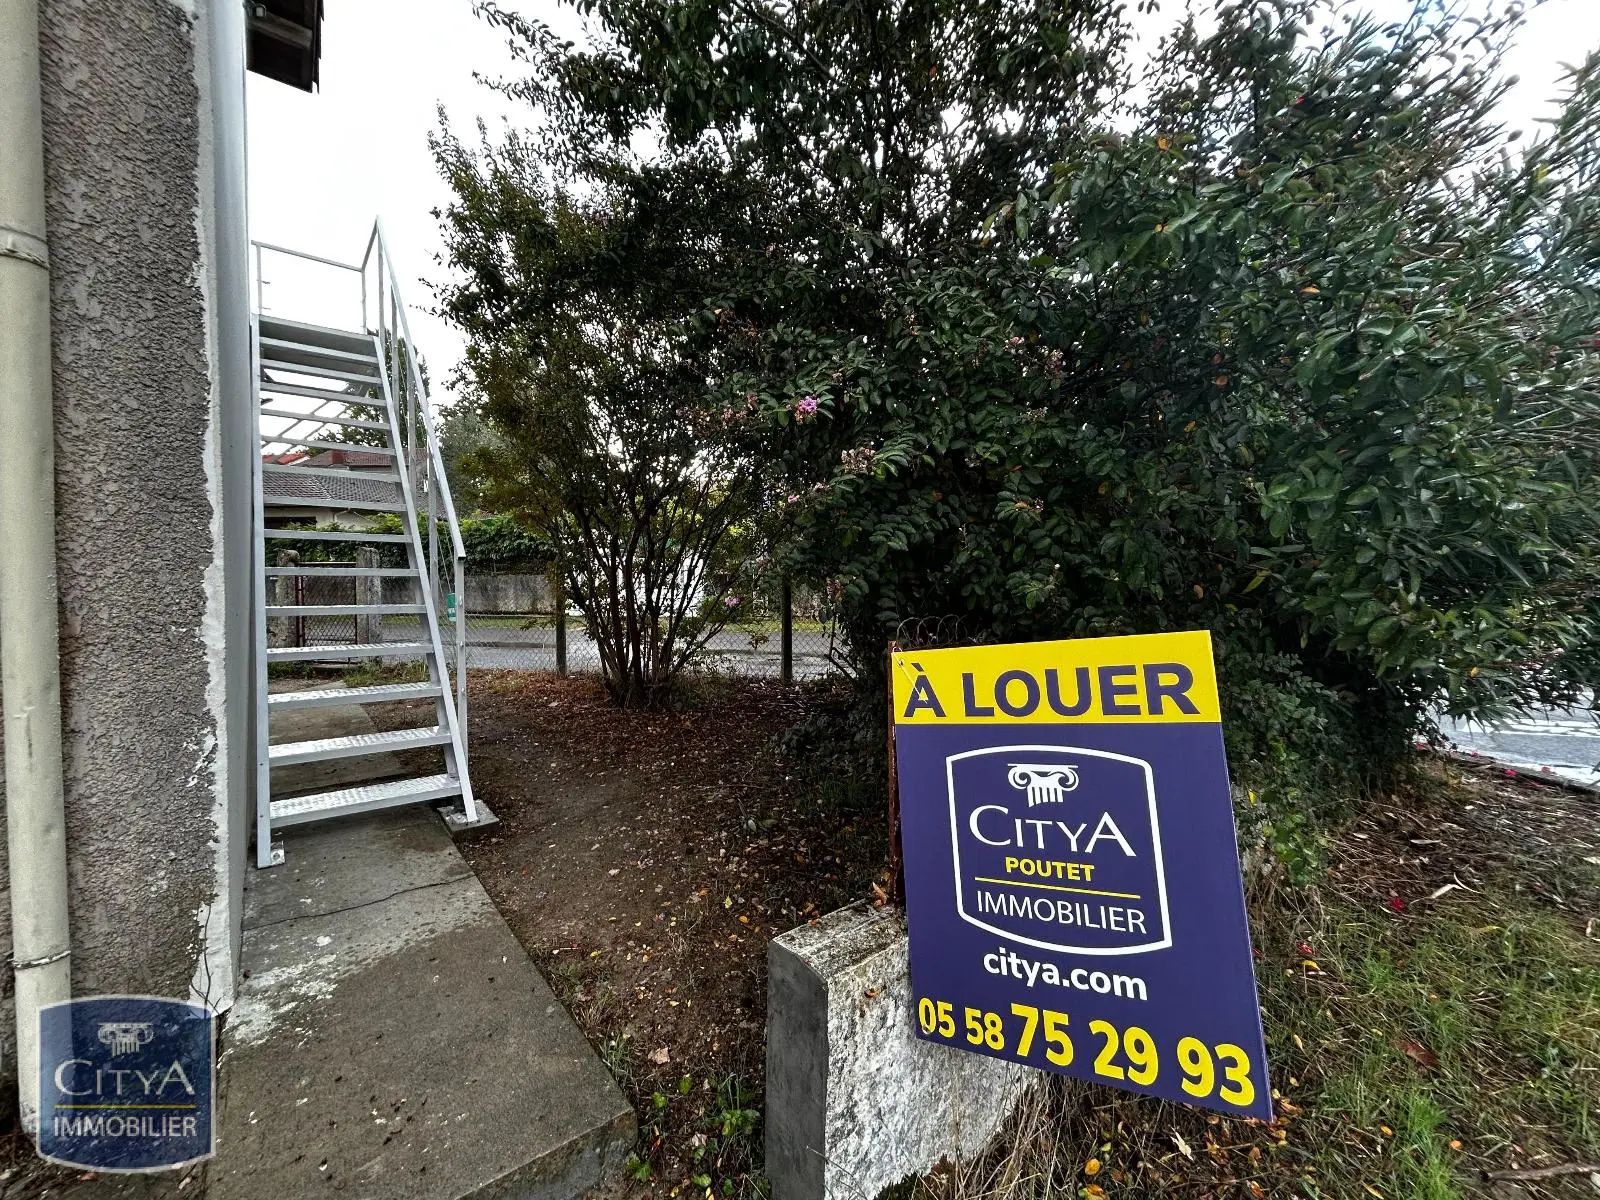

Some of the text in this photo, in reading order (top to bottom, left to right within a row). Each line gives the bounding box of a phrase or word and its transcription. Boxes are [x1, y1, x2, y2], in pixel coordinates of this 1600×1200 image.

[903, 662, 1200, 718] À LOUER
[969, 804, 1136, 857] CITYA
[1005, 857, 1094, 882] POUTET
[977, 890, 1147, 935] IMMOBILIER
[983, 946, 1147, 1000] citya.com
[918, 997, 1255, 1106] 05 58 75 29 93
